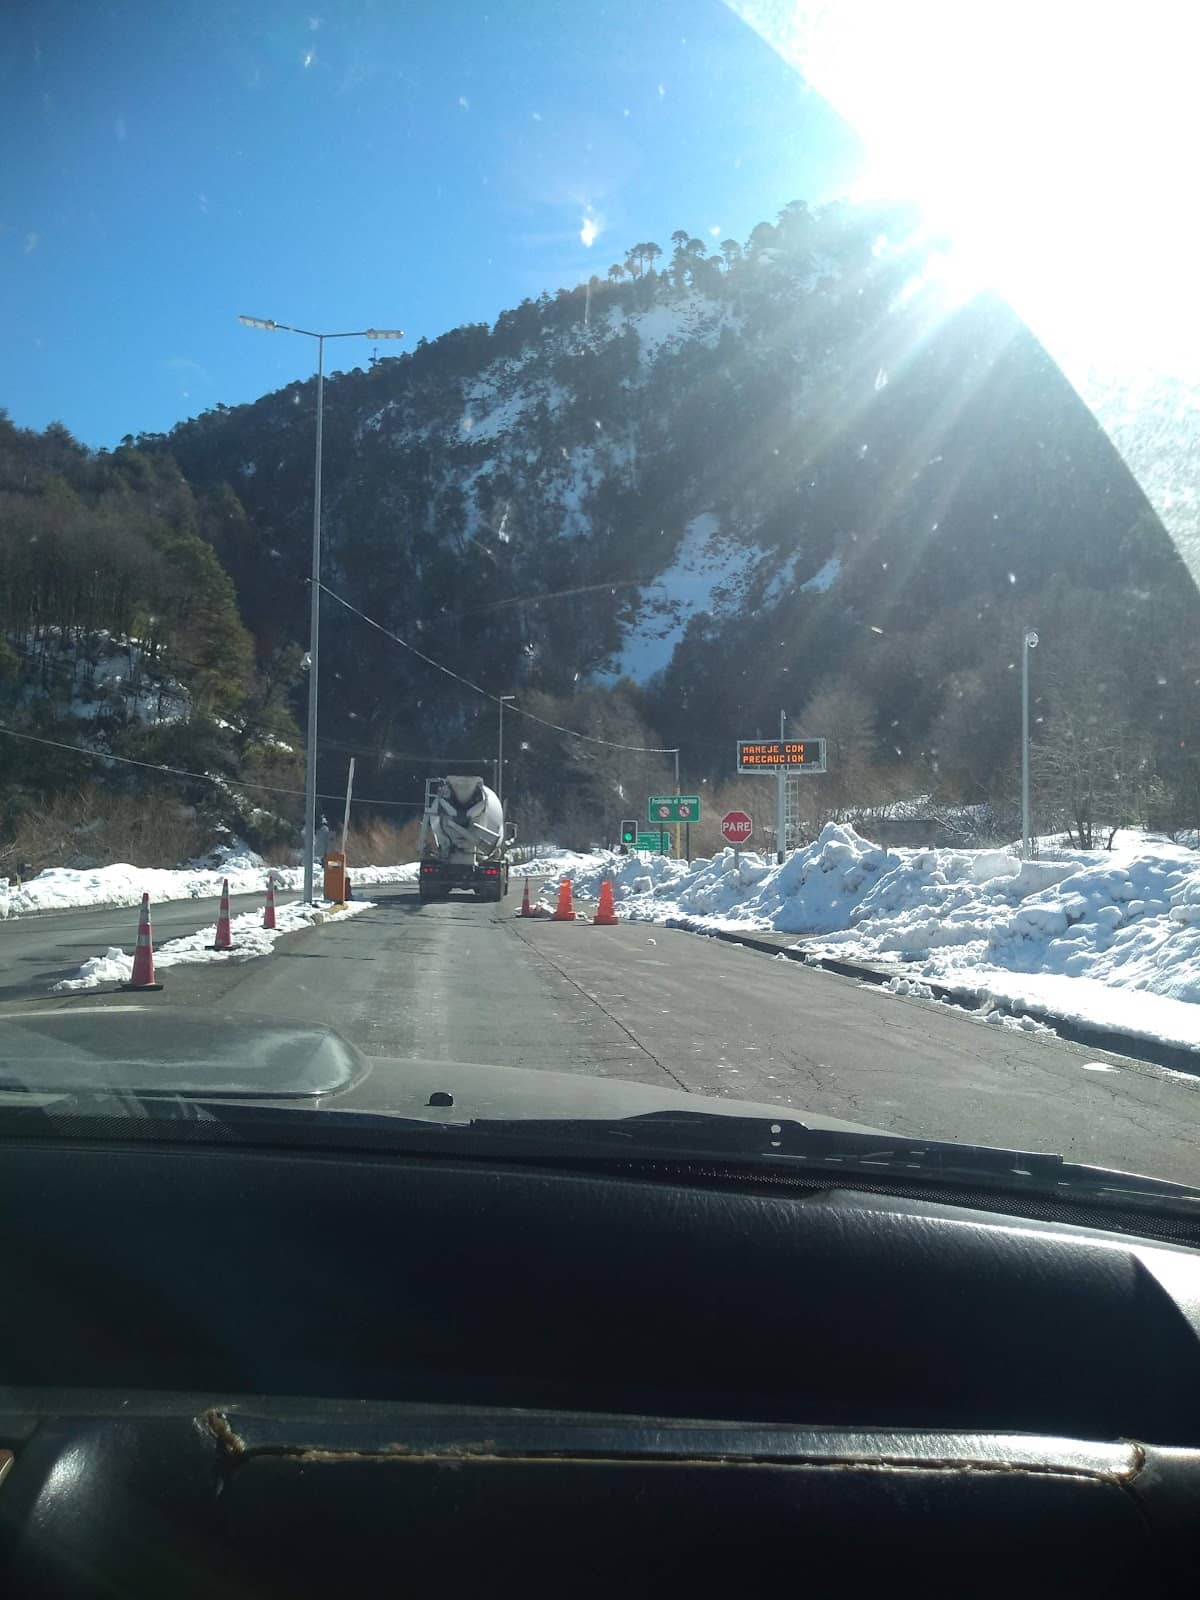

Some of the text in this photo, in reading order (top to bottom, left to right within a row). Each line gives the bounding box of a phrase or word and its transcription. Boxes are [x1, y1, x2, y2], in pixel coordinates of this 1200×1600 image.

[743, 744, 804, 753] MANEJE CON
[743, 754, 804, 763] PRECAUCION
[722, 822, 751, 832] PARE
